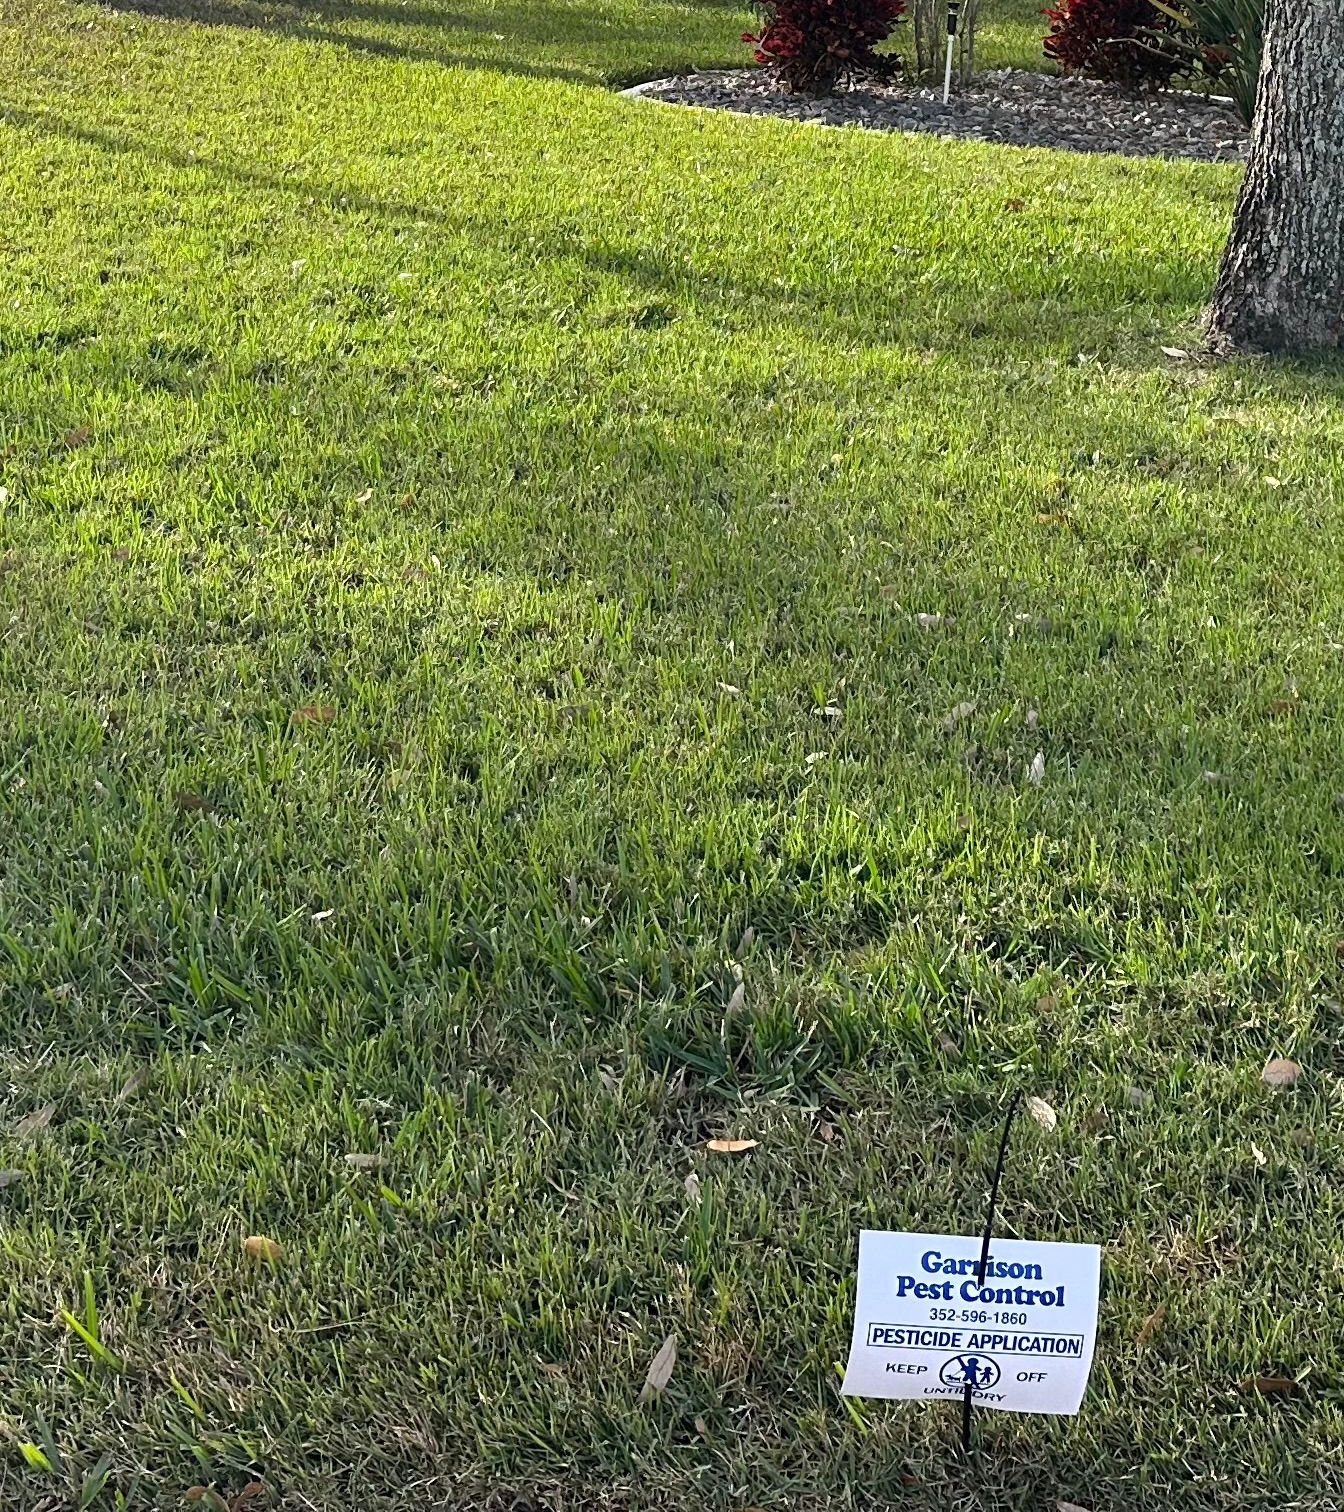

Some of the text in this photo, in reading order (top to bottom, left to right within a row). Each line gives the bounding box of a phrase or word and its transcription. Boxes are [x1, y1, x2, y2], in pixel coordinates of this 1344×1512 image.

[921, 1251, 1043, 1280] Garrison
[896, 1275, 1065, 1307] Pest Control
[930, 1308, 1027, 1326] 352-596-1860
[873, 1328, 1080, 1354] PESTICIDE APPLICATION
[885, 1362, 1048, 1383] KEEP OFF
[972, 1391, 1007, 1402] DRY
